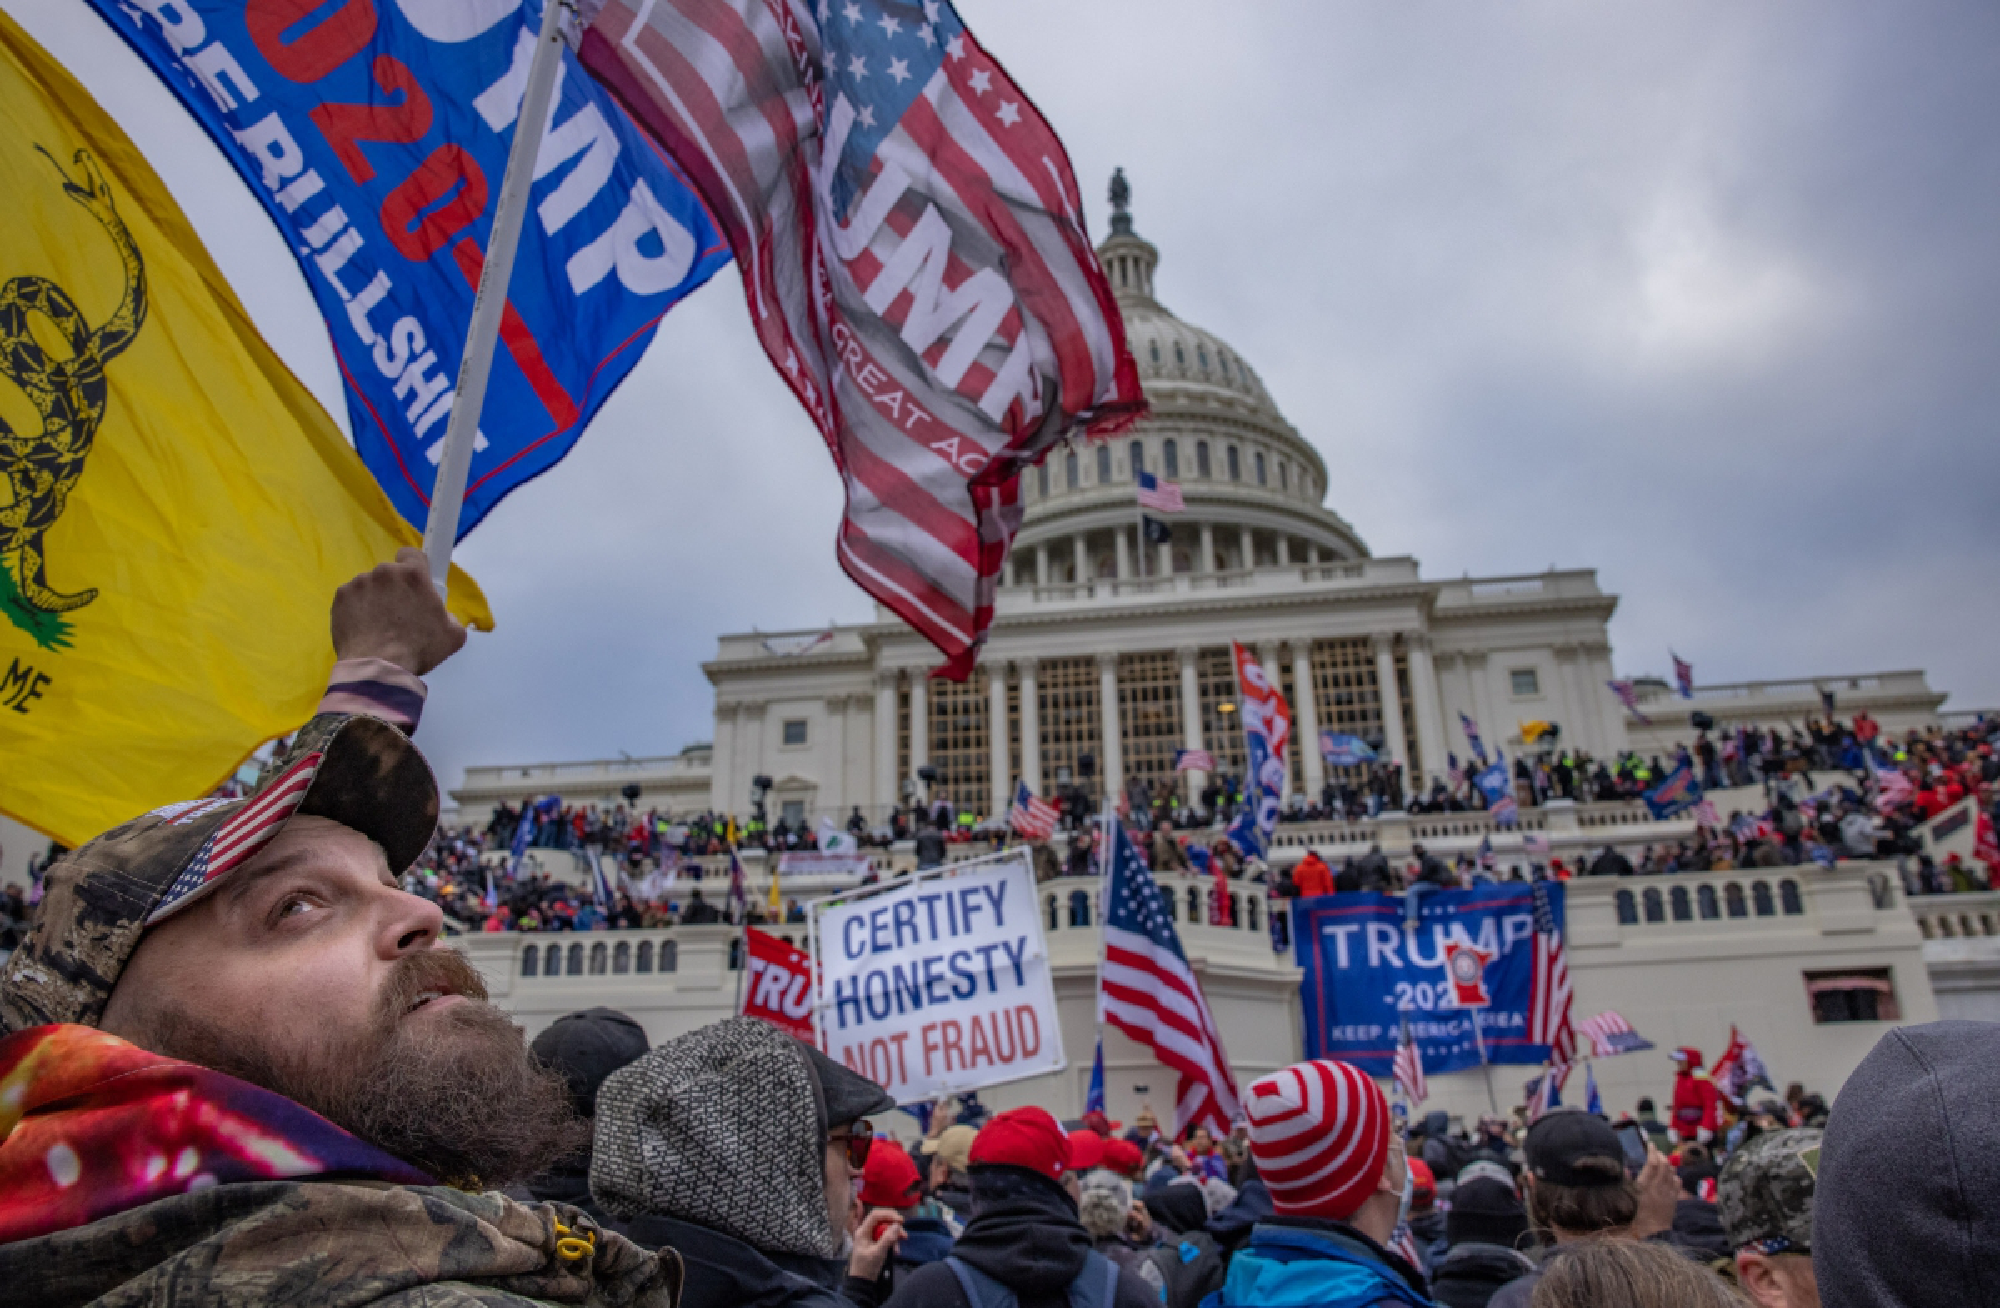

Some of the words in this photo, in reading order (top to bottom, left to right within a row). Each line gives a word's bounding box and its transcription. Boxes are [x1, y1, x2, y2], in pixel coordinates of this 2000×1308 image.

[831, 322, 932, 429] GREAT
[0, 656, 53, 715] ME
[841, 879, 1008, 961] CERTIFY
[1321, 913, 1533, 970] TRUMP
[832, 935, 1028, 1030] HONESTY
[842, 1031, 908, 1091] NOT
[920, 1004, 1042, 1078] FRAUD
